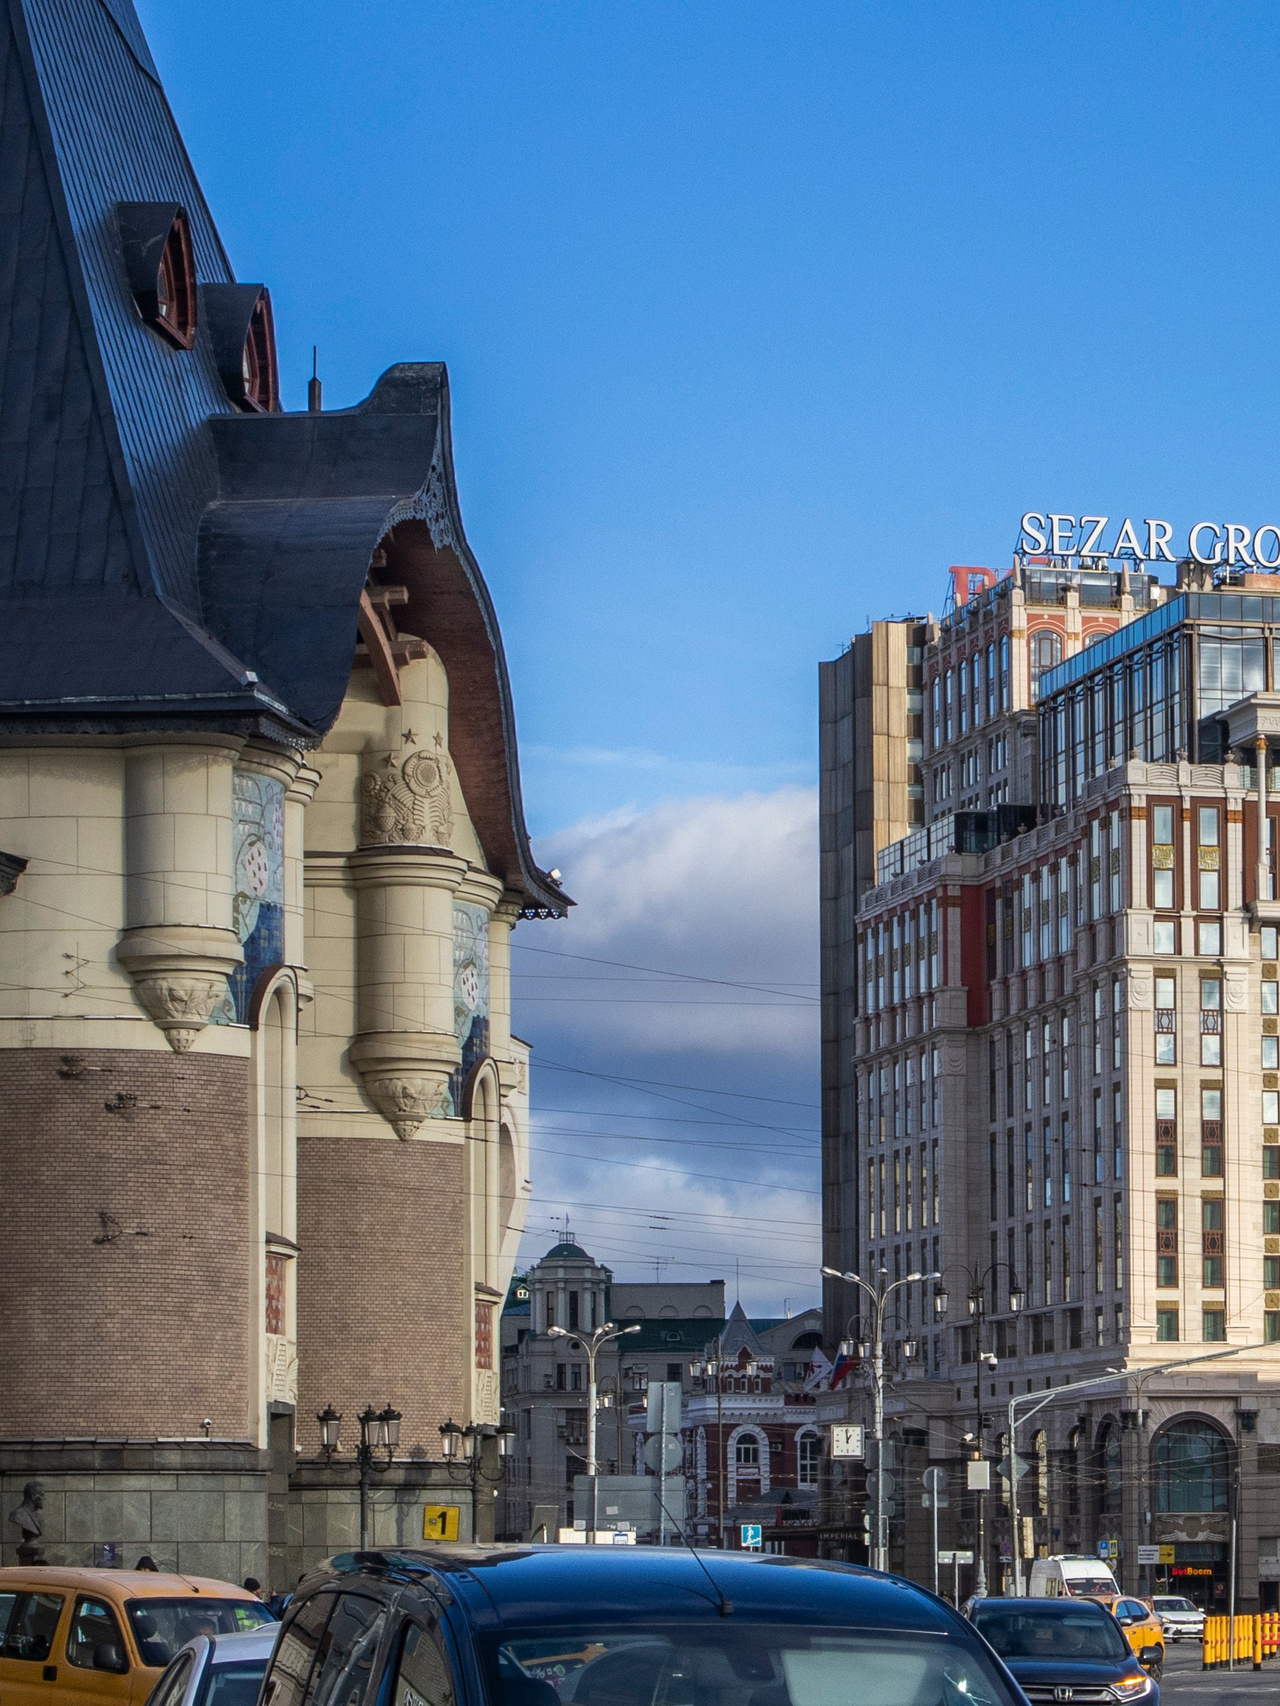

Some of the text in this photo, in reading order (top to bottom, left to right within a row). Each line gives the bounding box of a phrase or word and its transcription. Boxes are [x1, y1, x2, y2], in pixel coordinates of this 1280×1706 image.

[1020, 511, 1177, 562] SEZAR
[437, 1511, 447, 1535] 1
[820, 1532, 858, 1540] IMPERIAL
[1172, 1567, 1213, 1576] BetBoom
